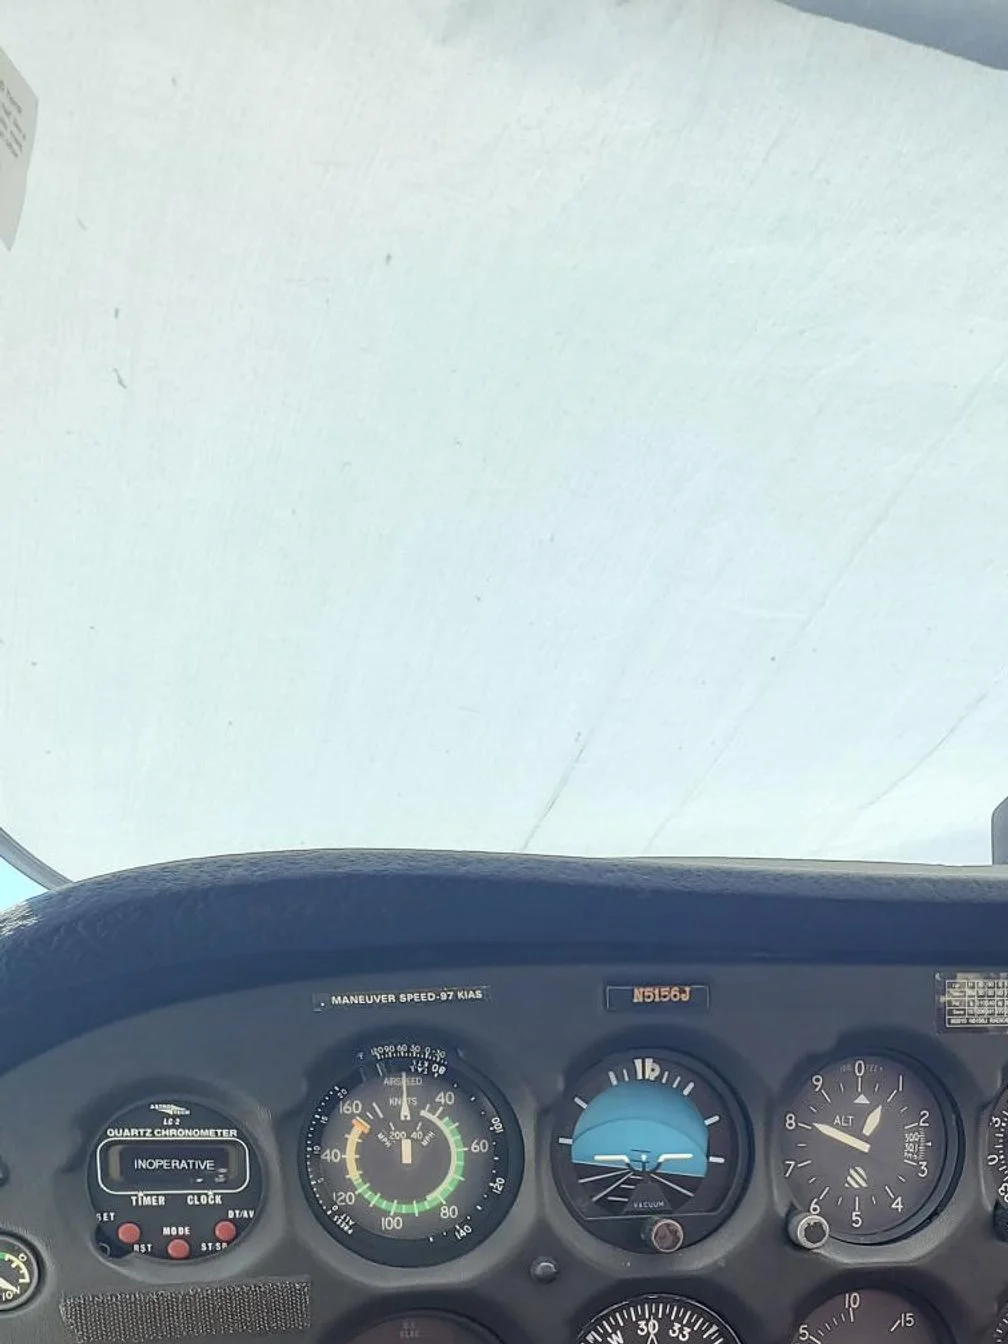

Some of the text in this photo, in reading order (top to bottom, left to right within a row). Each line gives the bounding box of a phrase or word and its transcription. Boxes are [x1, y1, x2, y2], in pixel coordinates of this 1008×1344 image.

[332, 990, 482, 1005] MANEUVER SPEED-97 KIAS
[634, 987, 690, 1002] N5156J
[855, 1061, 863, 1076] 0
[812, 1075, 822, 1090] 9
[899, 1075, 903, 1091] 1
[390, 1097, 417, 1105] KNTS
[436, 1092, 454, 1104] 40
[340, 1101, 362, 1113] 160
[785, 1115, 795, 1130] 8
[834, 1116, 853, 1126] ALT
[919, 1111, 929, 1126] 2
[107, 1128, 237, 1137] QUARTZ CHRONOMETER
[471, 1140, 488, 1152] 60
[135, 1159, 215, 1170] INOPERATIVE
[785, 1162, 793, 1176] 7
[918, 1162, 928, 1177] 3
[131, 1196, 165, 1206] TIMER
[187, 1195, 222, 1205] CLOCK
[334, 1192, 355, 1204] 120
[892, 1197, 903, 1212] 4
[440, 1206, 458, 1218] 80
[810, 1199, 820, 1214] 6
[382, 1217, 402, 1229] 100
[852, 1212, 862, 1227] 5
[163, 1227, 190, 1235] MODE
[134, 1244, 151, 1252] RST
[846, 1293, 859, 1308] 10
[637, 1320, 658, 1334] 30
[901, 1313, 914, 1327] 15
[669, 1323, 691, 1341] 33
[799, 1326, 808, 1340] 5
